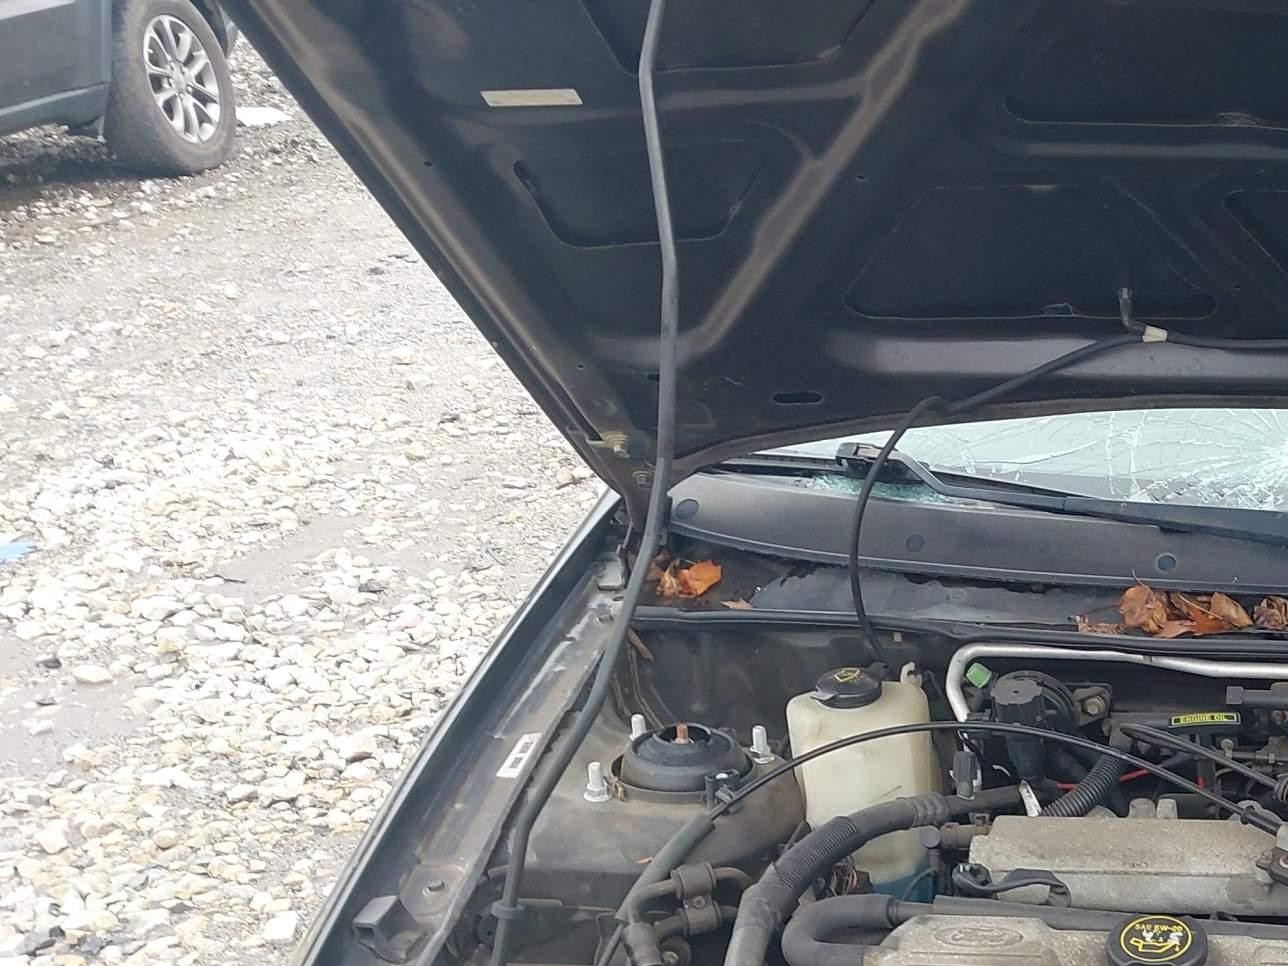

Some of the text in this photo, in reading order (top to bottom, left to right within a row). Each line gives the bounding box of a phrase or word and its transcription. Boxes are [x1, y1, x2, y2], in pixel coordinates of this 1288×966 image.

[1180, 713, 1228, 724] ENGINE OIL
[1134, 923, 1152, 931] SAE
